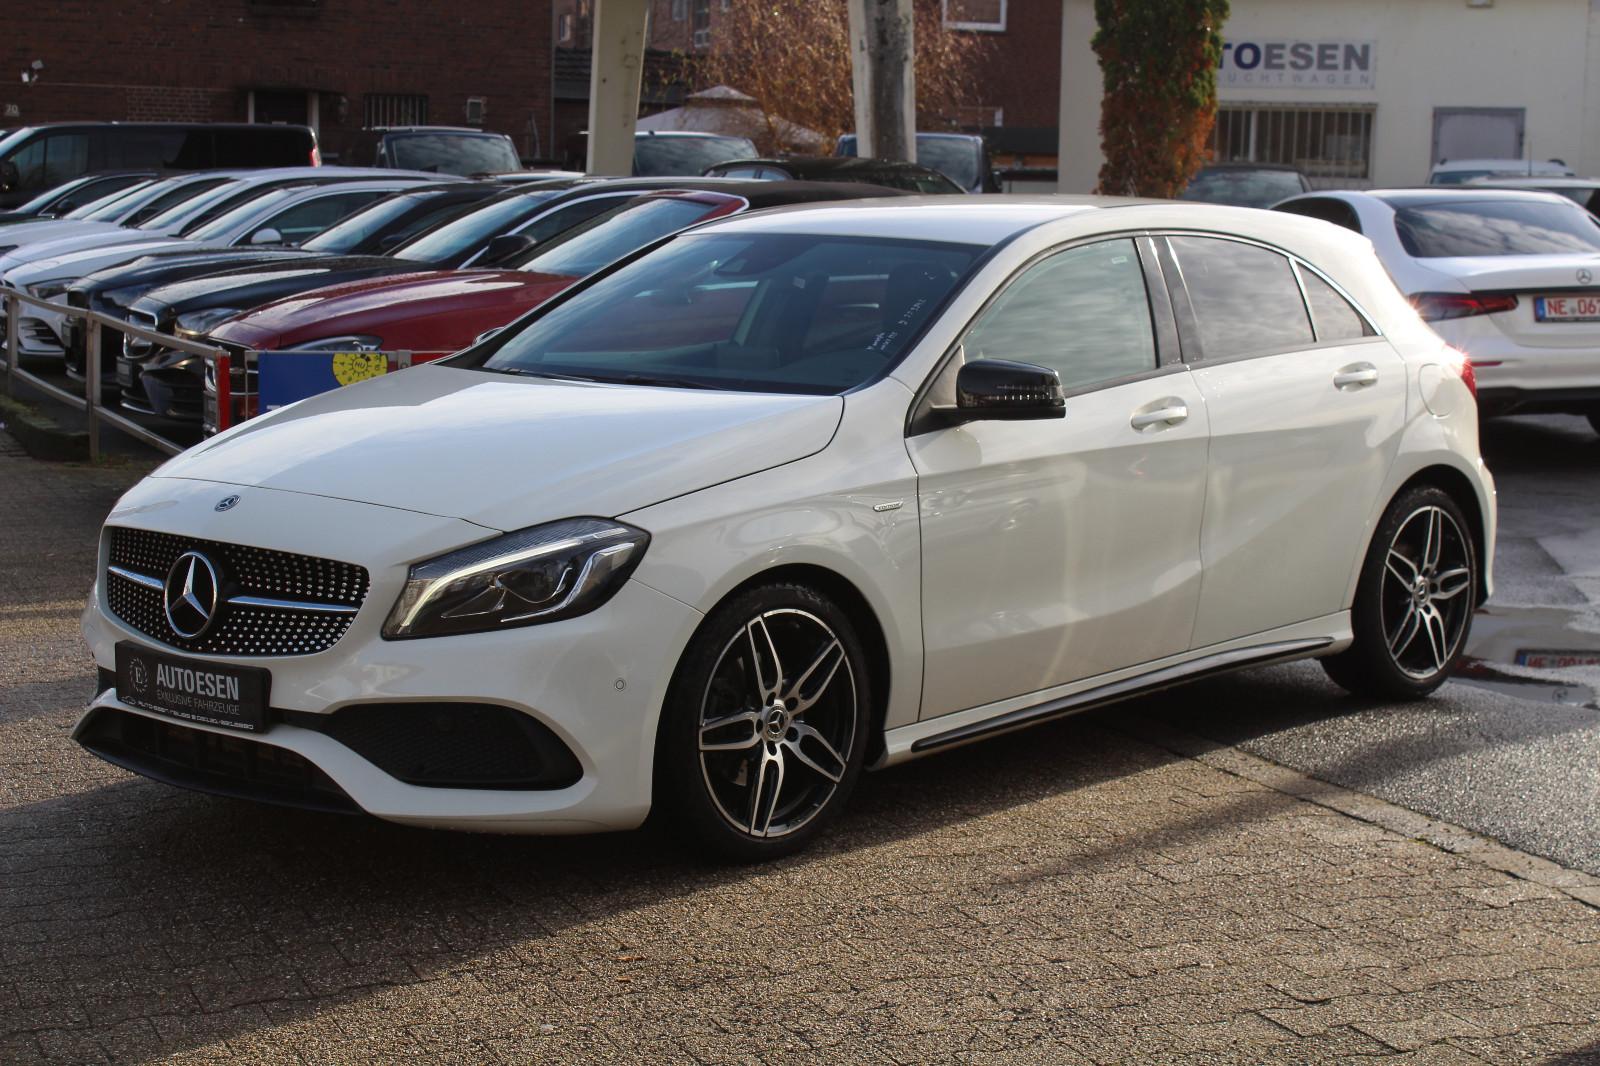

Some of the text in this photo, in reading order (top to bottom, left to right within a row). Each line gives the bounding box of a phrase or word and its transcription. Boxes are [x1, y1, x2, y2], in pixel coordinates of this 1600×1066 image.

[1547, 299, 1567, 315] NE
[156, 663, 239, 700] AUTOESEN
[193, 697, 240, 715] FAHRZEUGE
